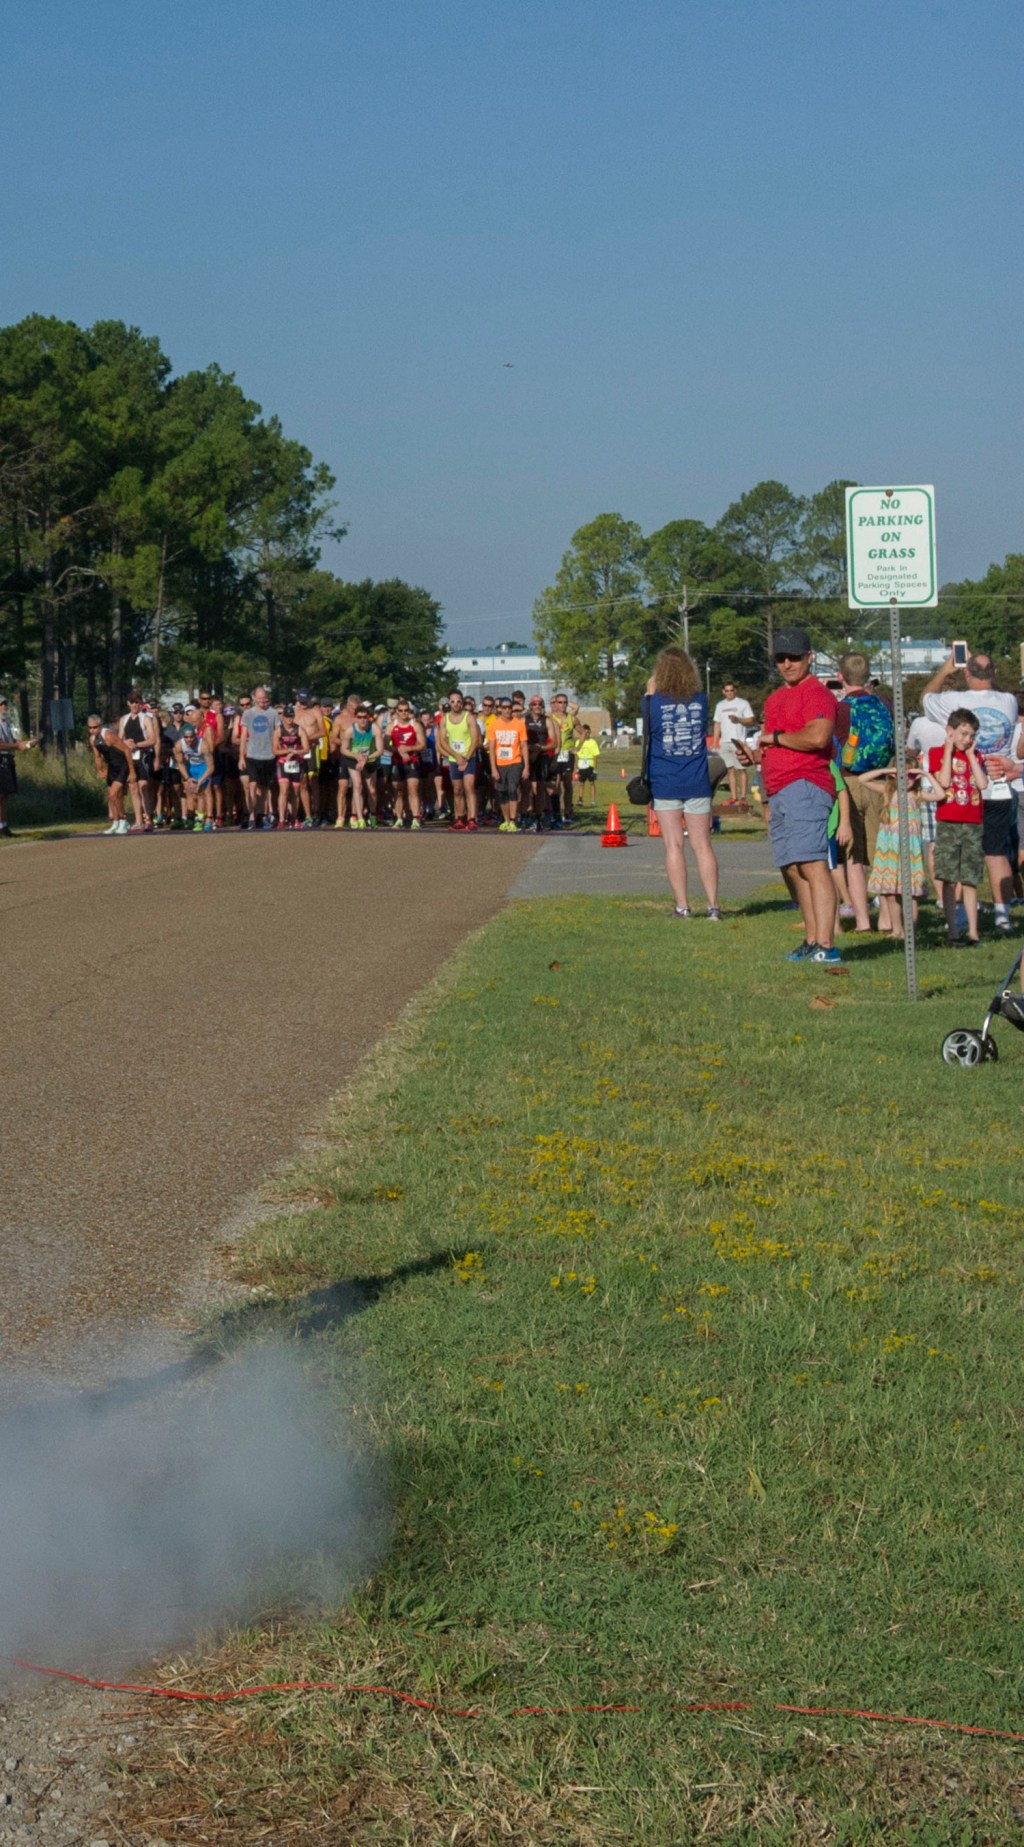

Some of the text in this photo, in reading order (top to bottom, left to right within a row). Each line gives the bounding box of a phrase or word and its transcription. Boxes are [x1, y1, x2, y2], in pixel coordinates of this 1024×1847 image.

[880, 499, 900, 509] NO
[858, 515, 923, 526] PARKING
[881, 532, 901, 542] ON
[868, 548, 916, 559] GRASS
[867, 573, 917, 581] Designated
[879, 589, 906, 597] Only
